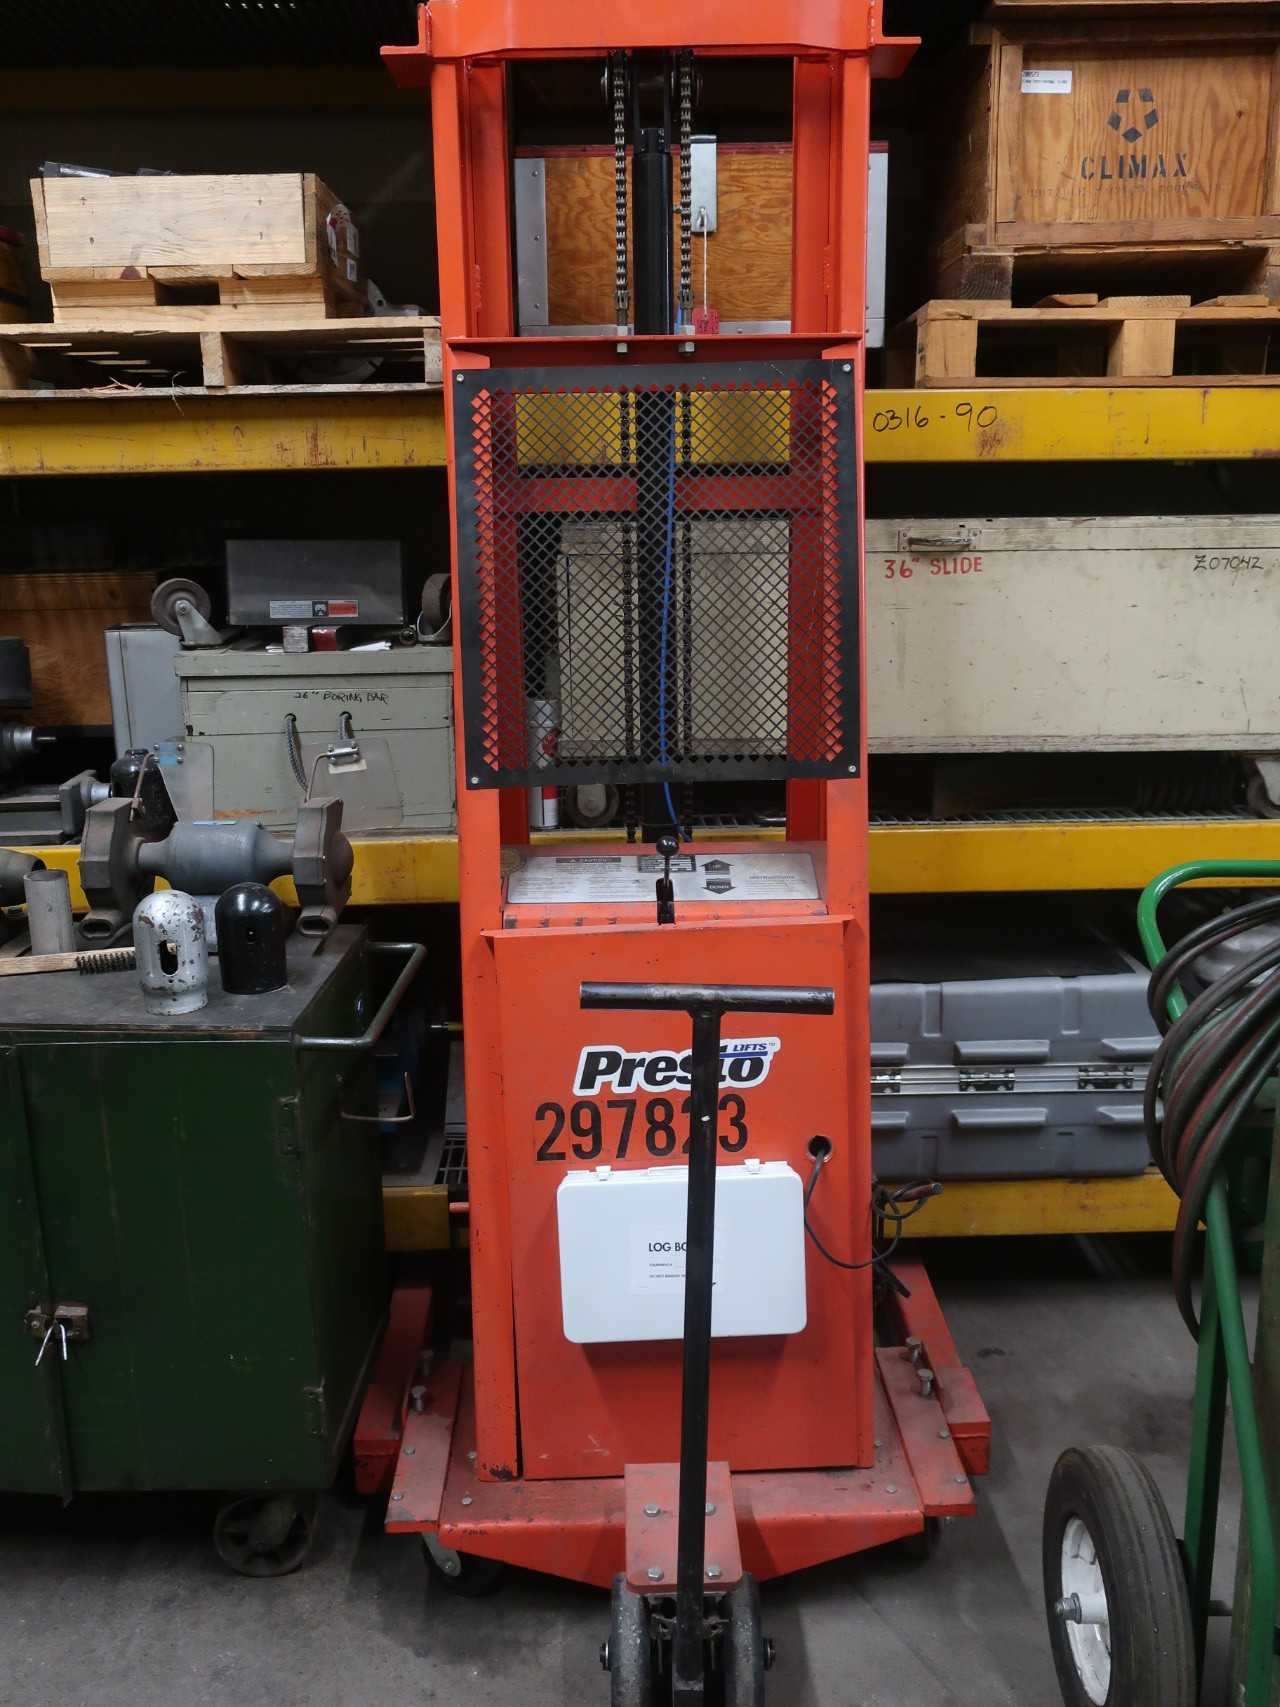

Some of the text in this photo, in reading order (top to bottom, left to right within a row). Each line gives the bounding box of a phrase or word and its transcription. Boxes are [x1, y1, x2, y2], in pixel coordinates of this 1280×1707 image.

[1080, 152, 1188, 181] CLIMAX
[872, 405, 929, 432] 0316
[955, 402, 998, 432] 90
[884, 556, 983, 579] 36" SLIDE
[323, 690, 362, 703] BORING
[366, 692, 389, 704] BAR
[732, 1042, 768, 1052] LIFTS
[648, 1242, 687, 1252] LOG BO
